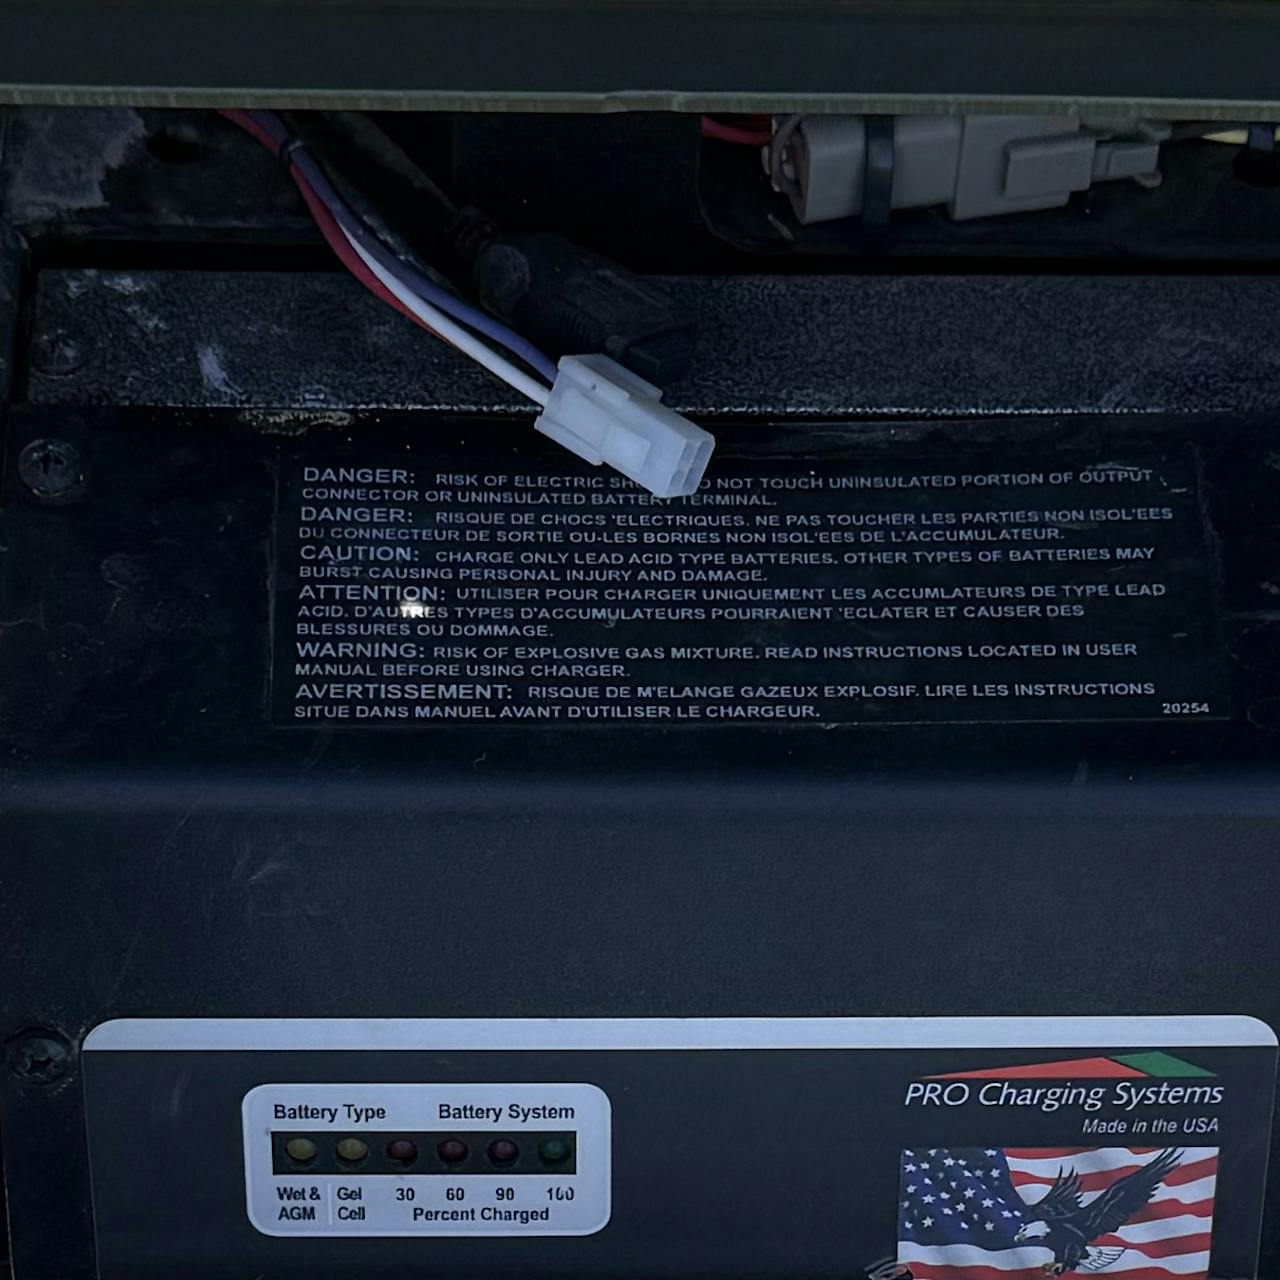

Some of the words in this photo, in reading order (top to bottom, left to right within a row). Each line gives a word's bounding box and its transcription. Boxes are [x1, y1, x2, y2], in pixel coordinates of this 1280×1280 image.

[299, 545, 420, 563] CAUTION:
[435, 551, 514, 564] CHARGE
[520, 552, 569, 564] ONLY
[574, 552, 624, 565] LEAD
[628, 553, 673, 564] ACID
[678, 553, 725, 565] TYPE
[731, 553, 839, 565] BATTERIES.
[843, 552, 908, 564] OTHER
[913, 551, 973, 563] TYPES
[977, 550, 1002, 562] OF
[1008, 548, 1111, 562] BATTERIES
[1115, 547, 1155, 560] MAY
[296, 642, 425, 658] WARNING:
[433, 647, 478, 658] RISK
[483, 646, 509, 659] OF
[514, 647, 620, 659] EXPLOSIVE
[625, 648, 665, 659] GAS
[670, 647, 760, 659] MIXTURE.
[764, 647, 818, 658] READ
[823, 646, 963, 658] INSTRUCTIONS
[967, 644, 1057, 657] LOCATED
[1062, 644, 1081, 656] IN
[1085, 643, 1137, 656] USER
[295, 663, 377, 676] MANUAL
[382, 663, 460, 676] BEFORE
[466, 665, 525, 677] USING
[530, 664, 630, 677] CHARGER.
[295, 683, 512, 700] AVERTISSEMENT:
[528, 687, 599, 699] RISQUE
[605, 687, 631, 698] DE
[740, 686, 818, 698] GAZEUX
[823, 685, 920, 697] EXPLOSIF.
[924, 684, 968, 696] LIRE
[972, 684, 1009, 697] LES
[1014, 683, 1155, 696] INSTRUCTIONS
[294, 705, 350, 717] SITUE
[355, 705, 409, 718] DANS
[414, 706, 496, 718] MANUEL
[499, 706, 562, 718] AVANT
[567, 705, 672, 718] D'UTILISER
[676, 705, 701, 717] LE
[705, 705, 820, 717] CHARGEUR.
[1162, 702, 1210, 714] 20254
[904, 1083, 970, 1106] PRO
[978, 1082, 1107, 1111] Charging
[1112, 1082, 1225, 1110] Systems
[273, 1104, 339, 1123] Battery
[343, 1103, 386, 1123] Type
[438, 1103, 503, 1123] Battery
[508, 1103, 575, 1123] System
[1082, 1118, 1128, 1133] Made
[1131, 1119, 1148, 1132] in
[1151, 1118, 1178, 1133] the
[1183, 1117, 1219, 1133] USA
[276, 1187, 307, 1201] Wet
[308, 1187, 322, 1201] &
[336, 1187, 363, 1201] Gel
[395, 1188, 416, 1202] 30
[445, 1187, 465, 1202] 60
[495, 1188, 515, 1201] 90
[277, 1206, 316, 1220] AGM
[337, 1206, 366, 1220] Cell
[412, 1207, 476, 1221] Percent
[480, 1207, 550, 1224] Charged
